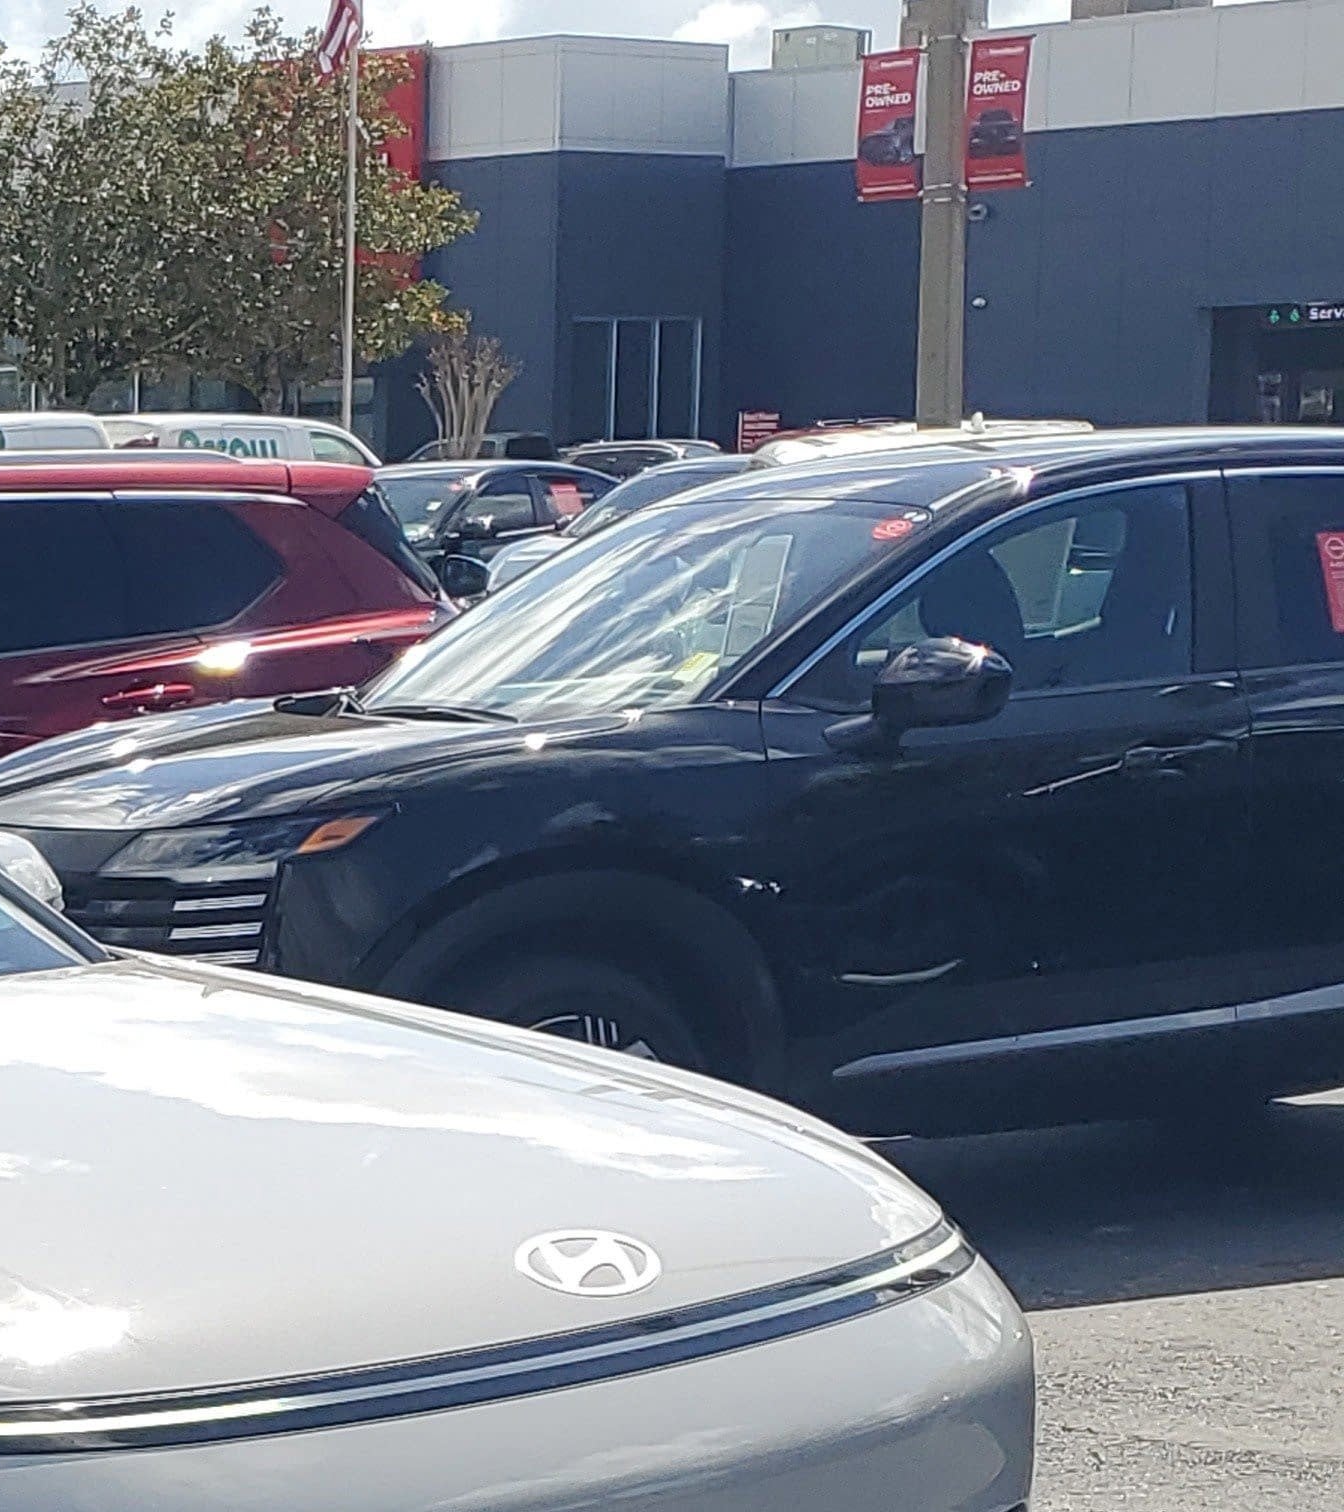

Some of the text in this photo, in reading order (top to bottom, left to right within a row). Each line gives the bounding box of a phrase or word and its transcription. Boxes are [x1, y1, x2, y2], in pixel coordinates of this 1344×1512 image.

[973, 70, 1006, 83] PRE-
[866, 83, 897, 95] PRE-
[973, 80, 1021, 95] OWNED
[865, 93, 911, 107] OWNED
[1309, 307, 1344, 320] Serv
